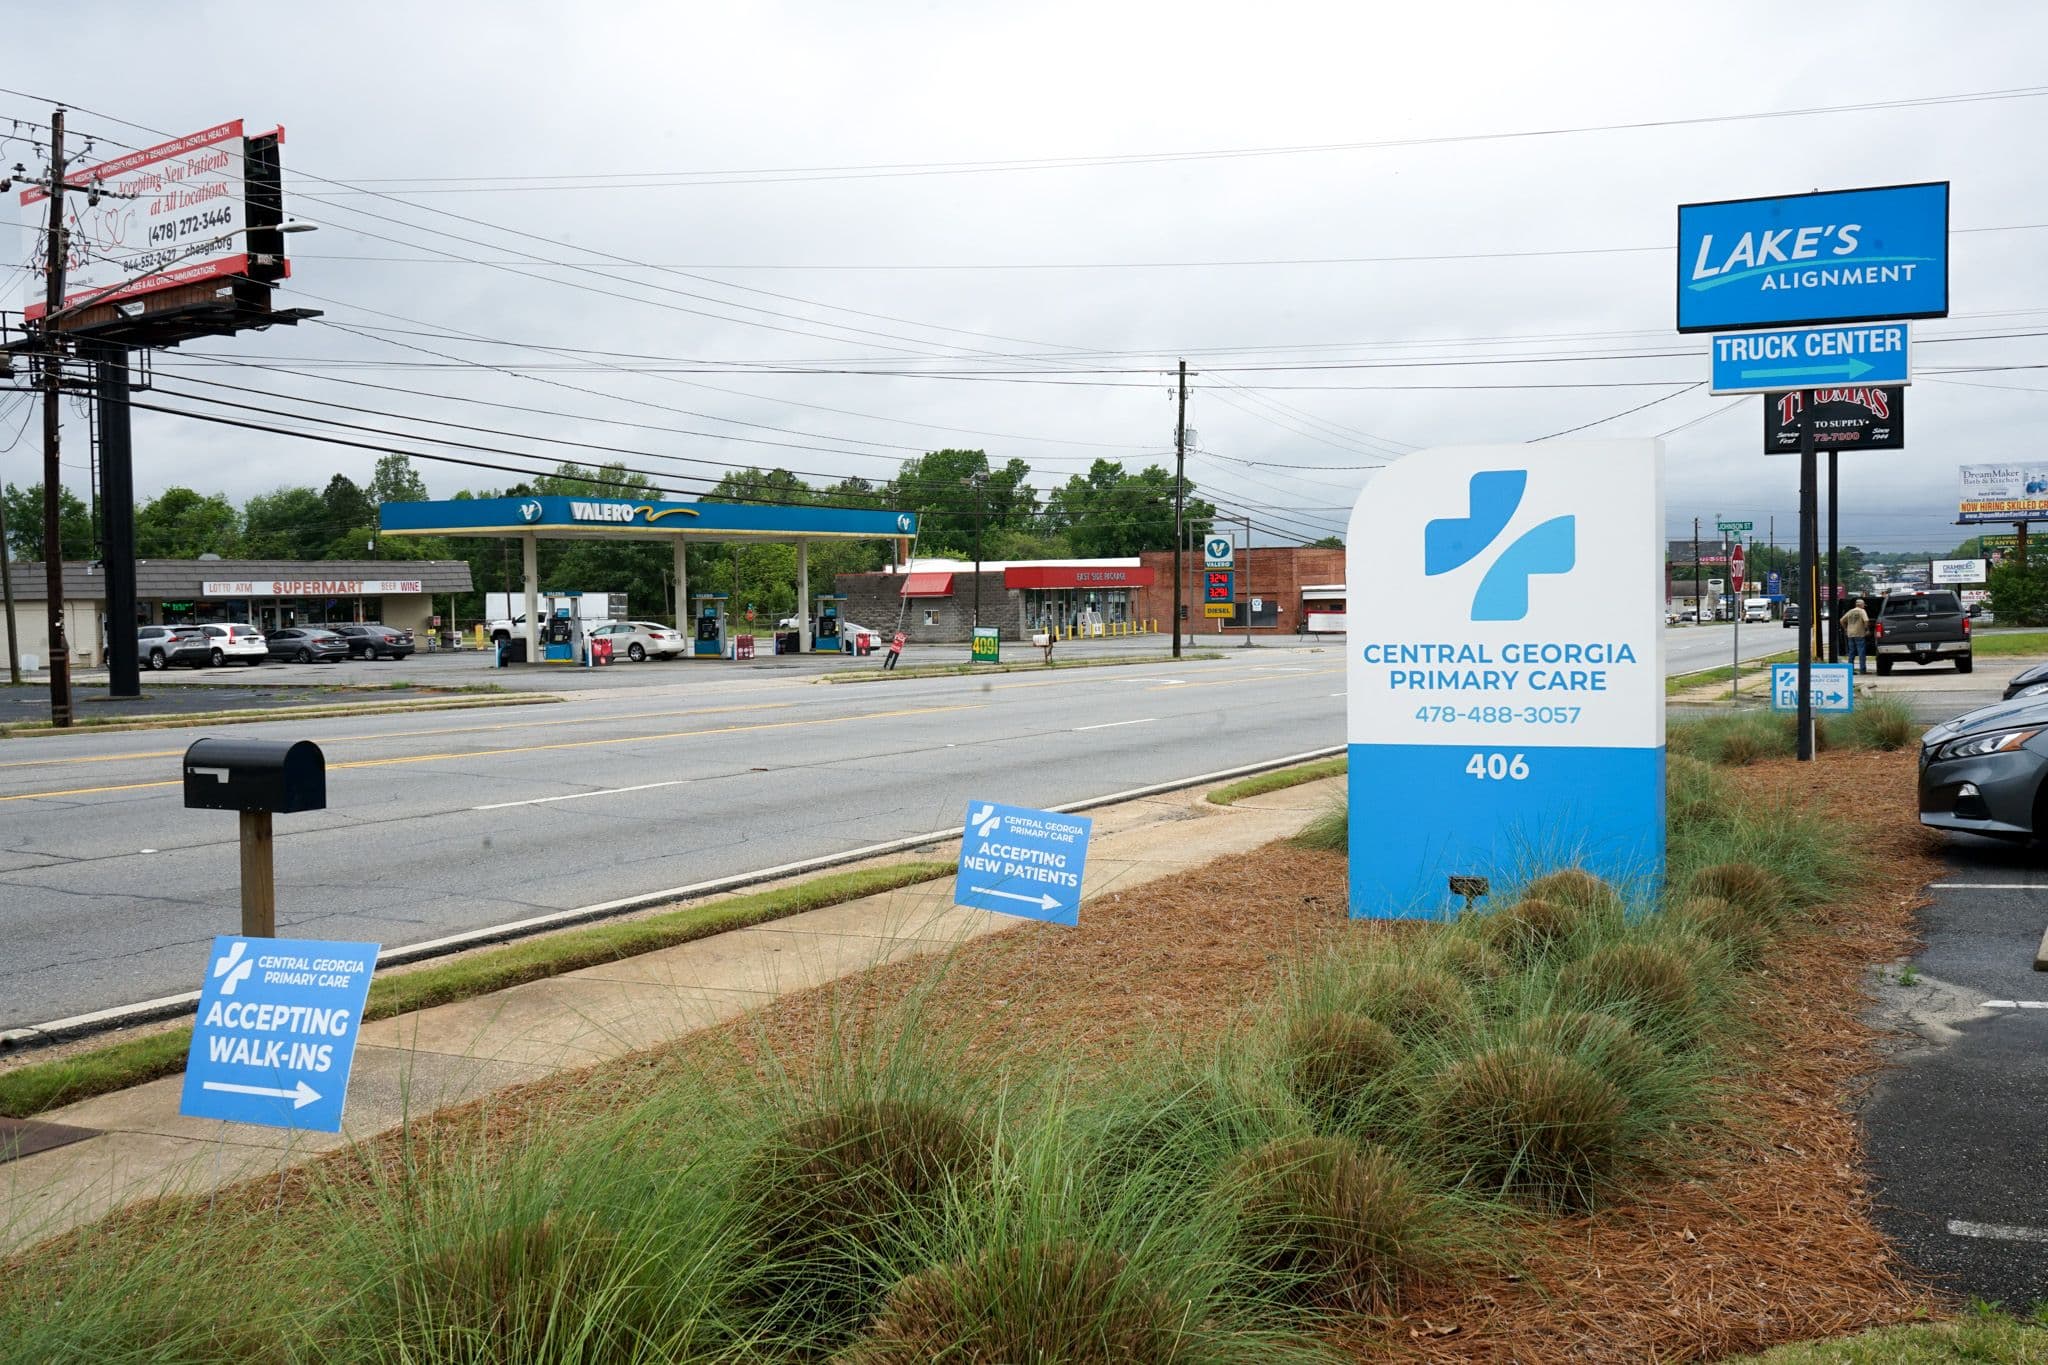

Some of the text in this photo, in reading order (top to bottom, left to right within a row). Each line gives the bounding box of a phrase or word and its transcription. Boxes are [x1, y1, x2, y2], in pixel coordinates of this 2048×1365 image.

[207, 126, 230, 141] HEALTH
[163, 165, 184, 185] New
[187, 150, 229, 178] Patients
[150, 198, 162, 216] at
[163, 191, 177, 213] All
[148, 205, 232, 247] (478) 272-3446
[1692, 224, 1862, 281] LAKE'S
[1761, 264, 1917, 291] ALIGNMENT
[1717, 329, 1902, 361] TRUCK CENTER
[1829, 419, 1865, 428] SUPPLY
[1963, 469, 2020, 479] DreamMaker
[570, 501, 635, 522] VALERO
[1961, 502, 1978, 512] NOW
[1980, 501, 2005, 511] HIRING
[2006, 500, 2036, 510] SKILLED
[1732, 560, 1744, 578] STOP
[209, 583, 231, 593] LOTTO
[272, 580, 364, 594] SUPERMART
[380, 581, 397, 591] BEER
[400, 581, 420, 592] WINE
[1363, 643, 1637, 664] CENTRAL GEORGIA
[1390, 670, 1607, 690] PRIMARY CARE
[1781, 690, 1824, 706] ENER
[1415, 706, 1581, 724] 478-488-3057
[1465, 753, 1530, 780] 406
[1004, 815, 1084, 835] CENTRAL GEORGIA
[1010, 825, 1075, 843] PRIMARY CARE
[979, 841, 1067, 868] ACCEPTING
[964, 855, 1078, 888] NEW PATIENTS
[258, 955, 365, 973] CENTRAL GEORGIA
[264, 971, 351, 988] PRIMARY CARE
[204, 1000, 350, 1037] ACCEPTING
[209, 1035, 333, 1073] WALK-INS
